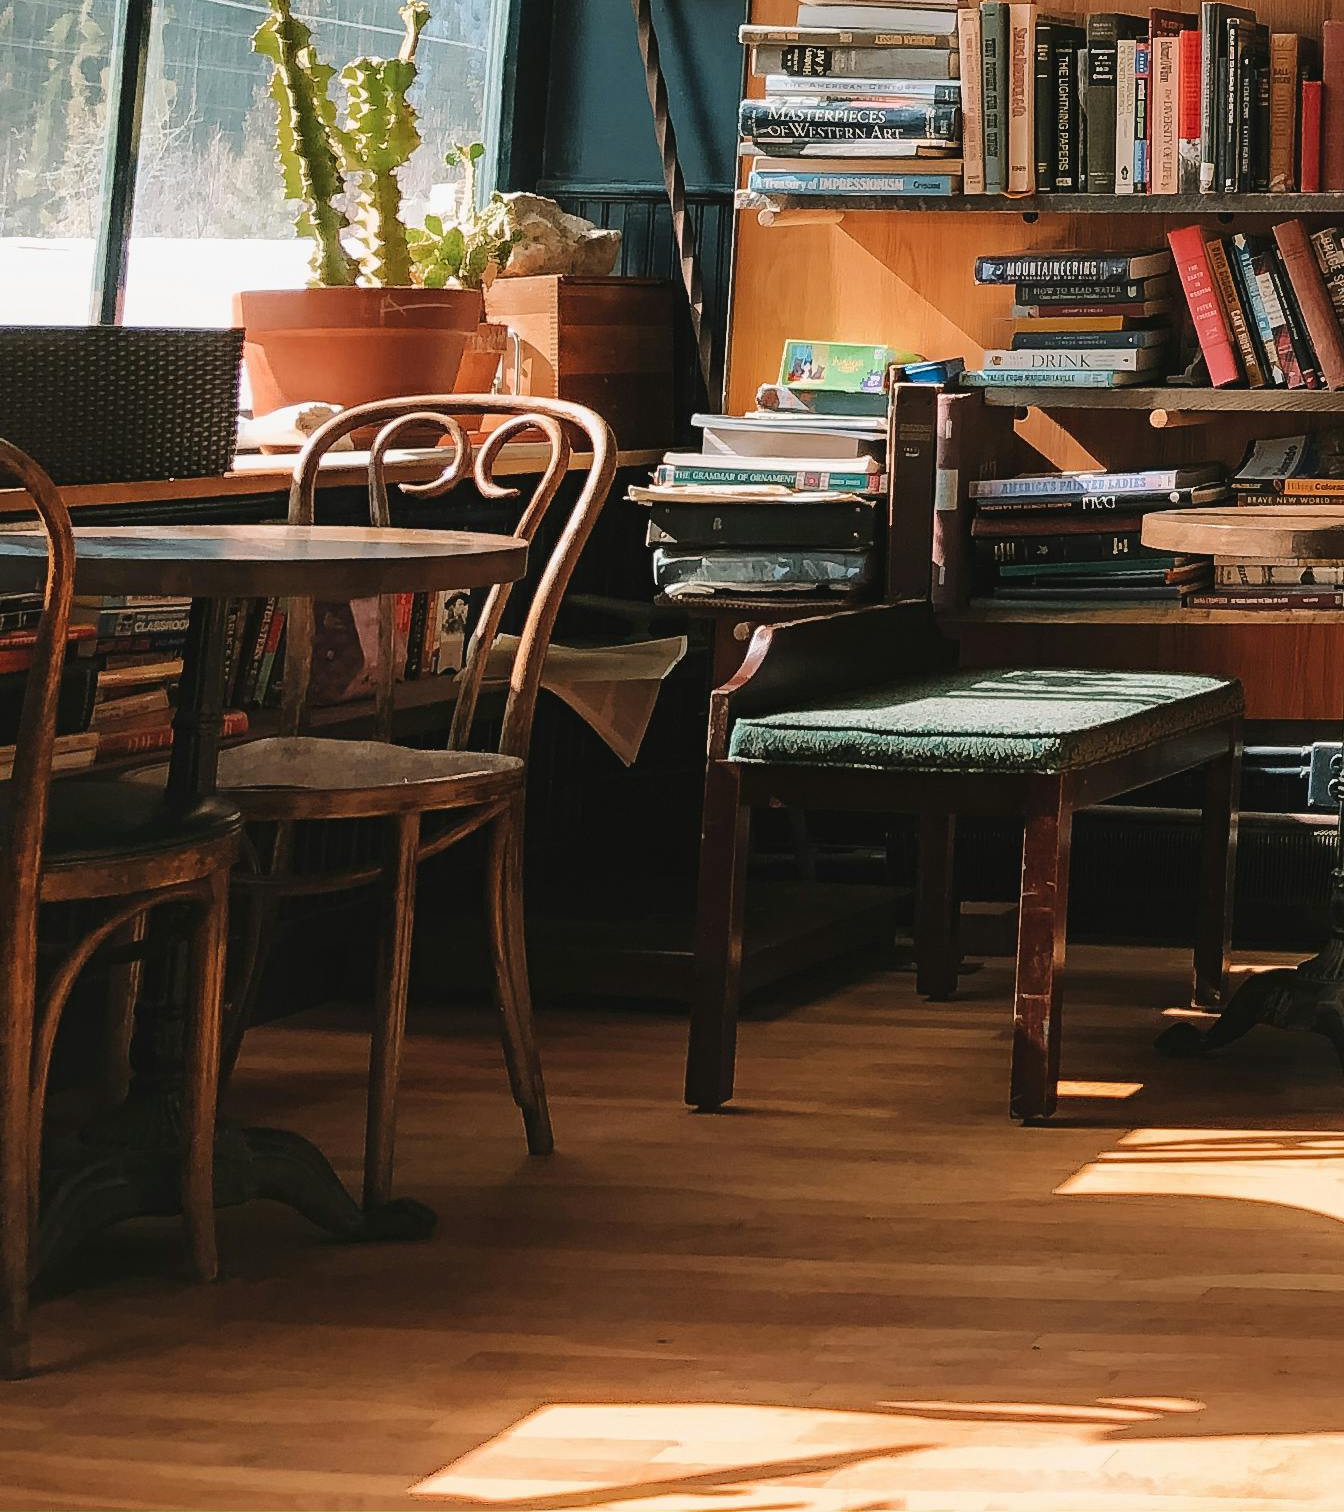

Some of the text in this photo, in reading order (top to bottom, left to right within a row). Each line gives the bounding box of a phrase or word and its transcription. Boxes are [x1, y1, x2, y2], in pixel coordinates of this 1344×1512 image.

[803, 48, 814, 76] History
[815, 48, 825, 76] of Art
[767, 105, 887, 124] MASTERPIECES
[1058, 56, 1069, 171] THE LIGHTNING PAPERS
[1162, 100, 1173, 145] DIVERSITY
[768, 122, 904, 140] OF WESTERN ART
[1162, 146, 1173, 161] OF
[1162, 161, 1172, 180] LIFE
[763, 177, 904, 192] Treasury of IMPRESSIONISM
[1320, 236, 1341, 273] BRUCE
[1006, 261, 1097, 276] MOUNTAINEERING
[1033, 286, 1122, 295] HOW TO READ WATER
[1230, 309, 1246, 332] CAN'T
[1237, 333, 1251, 354] HURT
[1031, 354, 1092, 368] DRINK
[1245, 354, 1256, 367] ME
[675, 471, 796, 484] THE GRAMMAR OF ORNAMENT
[1001, 476, 1147, 494] AMERICA'S PAINTED LADIES
[1247, 496, 1331, 504] BRAVE NEW WORLD
